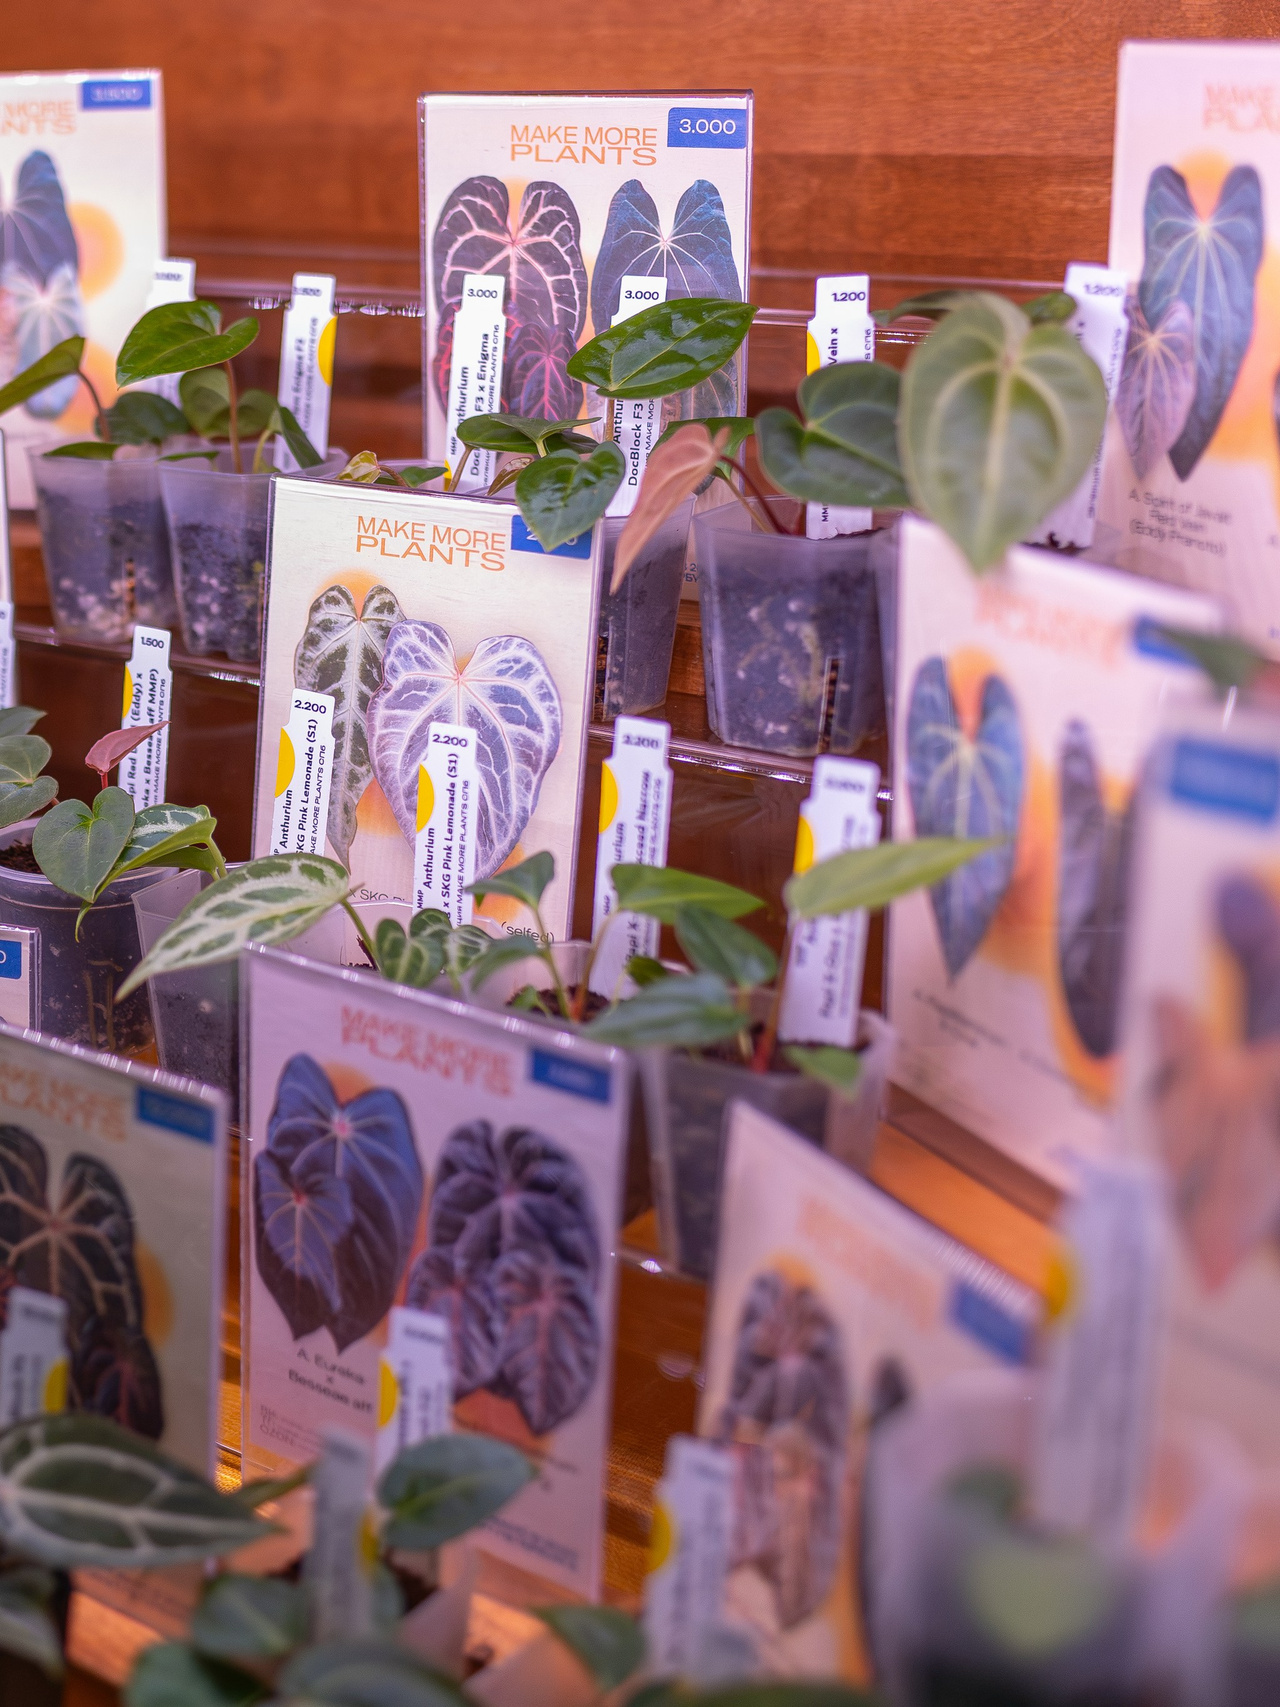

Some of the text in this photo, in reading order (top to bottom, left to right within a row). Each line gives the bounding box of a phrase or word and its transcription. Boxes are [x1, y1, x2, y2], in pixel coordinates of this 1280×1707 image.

[510, 124, 658, 147] MAKE MORE
[678, 118, 737, 135] 3.000
[510, 144, 658, 166] PLANTS
[467, 288, 498, 299] 3.000
[624, 290, 660, 301] 3.000
[831, 291, 866, 302] 1.200
[477, 333, 490, 381] Enigma
[456, 366, 469, 428] nthurium
[475, 394, 485, 412] F3
[613, 398, 624, 443] Anthur
[628, 403, 644, 486] DocBlock F3
[357, 515, 426, 541] MAKE
[432, 525, 507, 552] MORE
[356, 535, 505, 572] PLANTS
[140, 636, 165, 649] 1.500
[130, 682, 143, 722] (Eddy)
[149, 668, 160, 705] MMP)
[147, 706, 156, 725] aff
[157, 700, 166, 739] PANTS
[294, 699, 327, 715] 2.200
[306, 719, 319, 743] (S1)
[432, 733, 468, 748] 2.200
[127, 757, 137, 780] Red
[143, 733, 155, 775] Bessea
[303, 746, 315, 805] Lemonade
[315, 767, 325, 806] PLANTS
[279, 789, 293, 849] Anthurium
[298, 807, 309, 831] Pink
[312, 806, 321, 831] MORE
[441, 753, 460, 909] x SKG Pink Lemonade (S1)
[460, 802, 468, 842] PLANTS
[422, 828, 436, 890] Anthurium
[458, 845, 466, 874] MORE
[614, 822, 625, 866] urium
[501, 921, 556, 945] (selfed)
